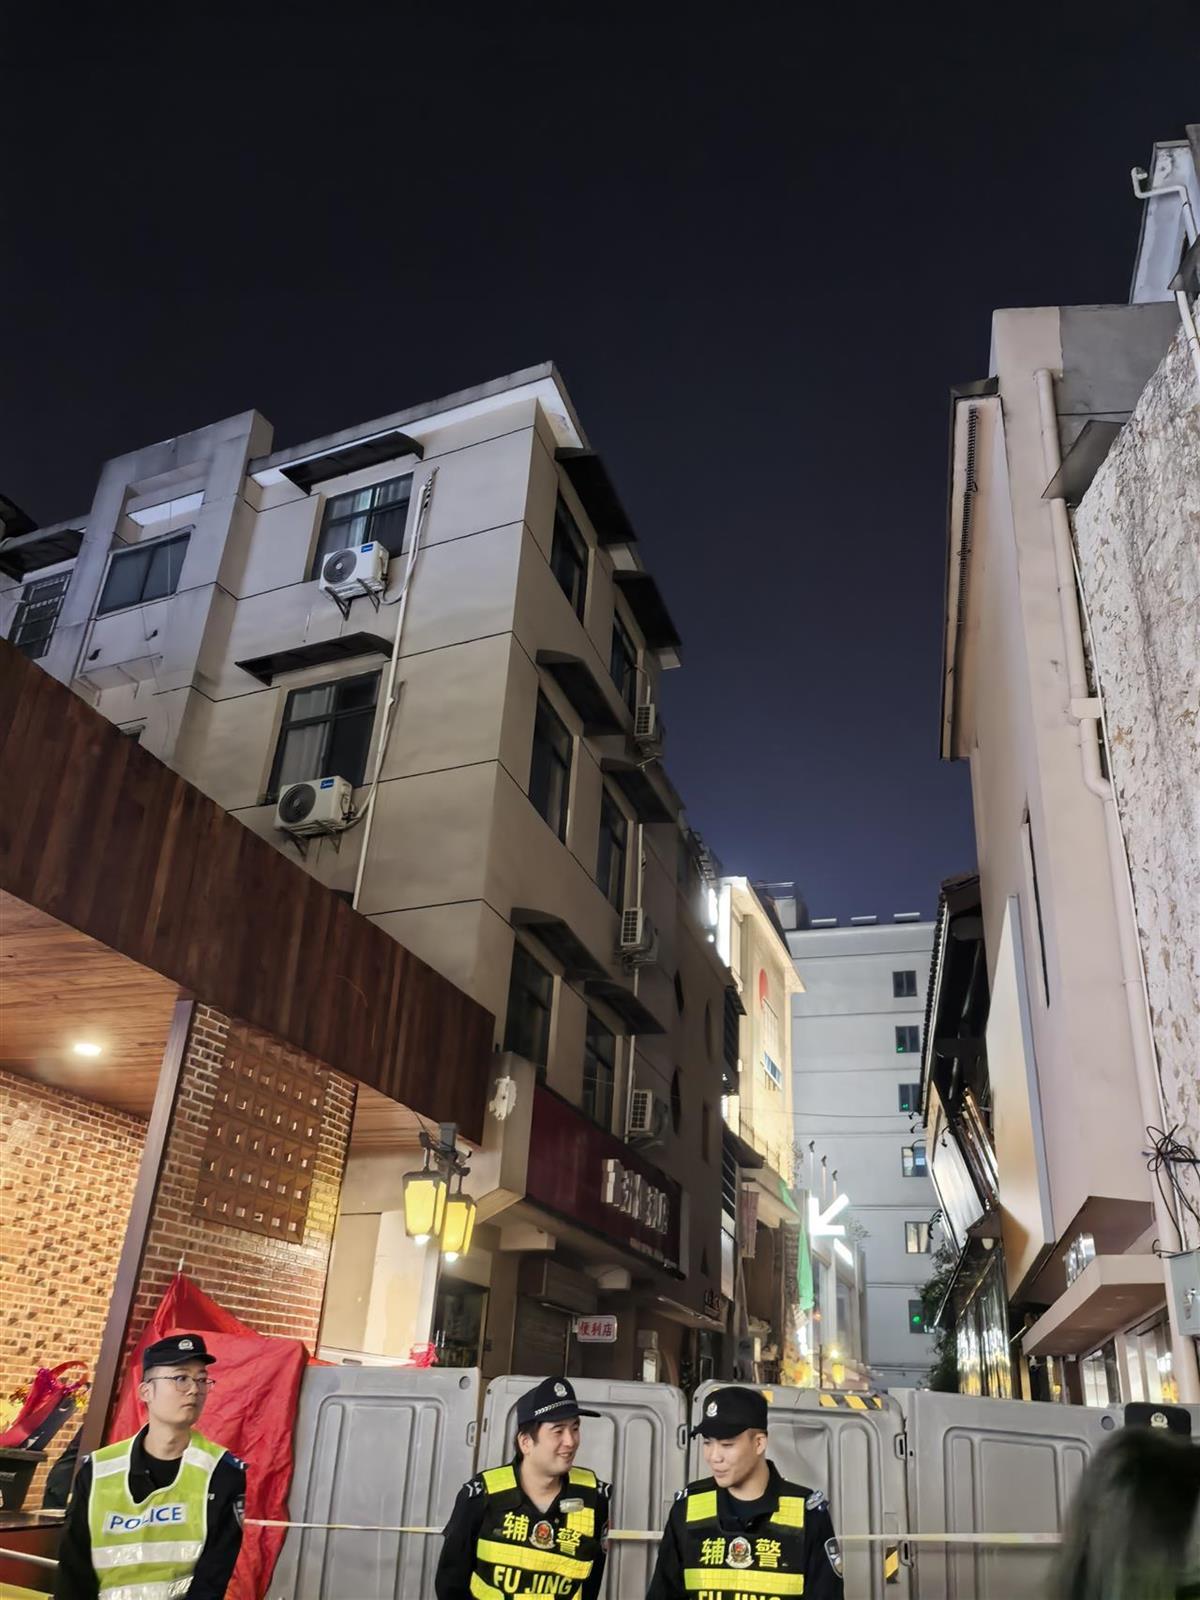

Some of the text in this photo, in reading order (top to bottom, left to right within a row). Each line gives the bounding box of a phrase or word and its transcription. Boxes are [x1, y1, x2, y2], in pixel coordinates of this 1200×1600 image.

[109, 1506, 182, 1530] POICE
[502, 1511, 581, 1556] 辅警
[700, 1537, 782, 1568] 辅警
[493, 1565, 573, 1595] FU JING
